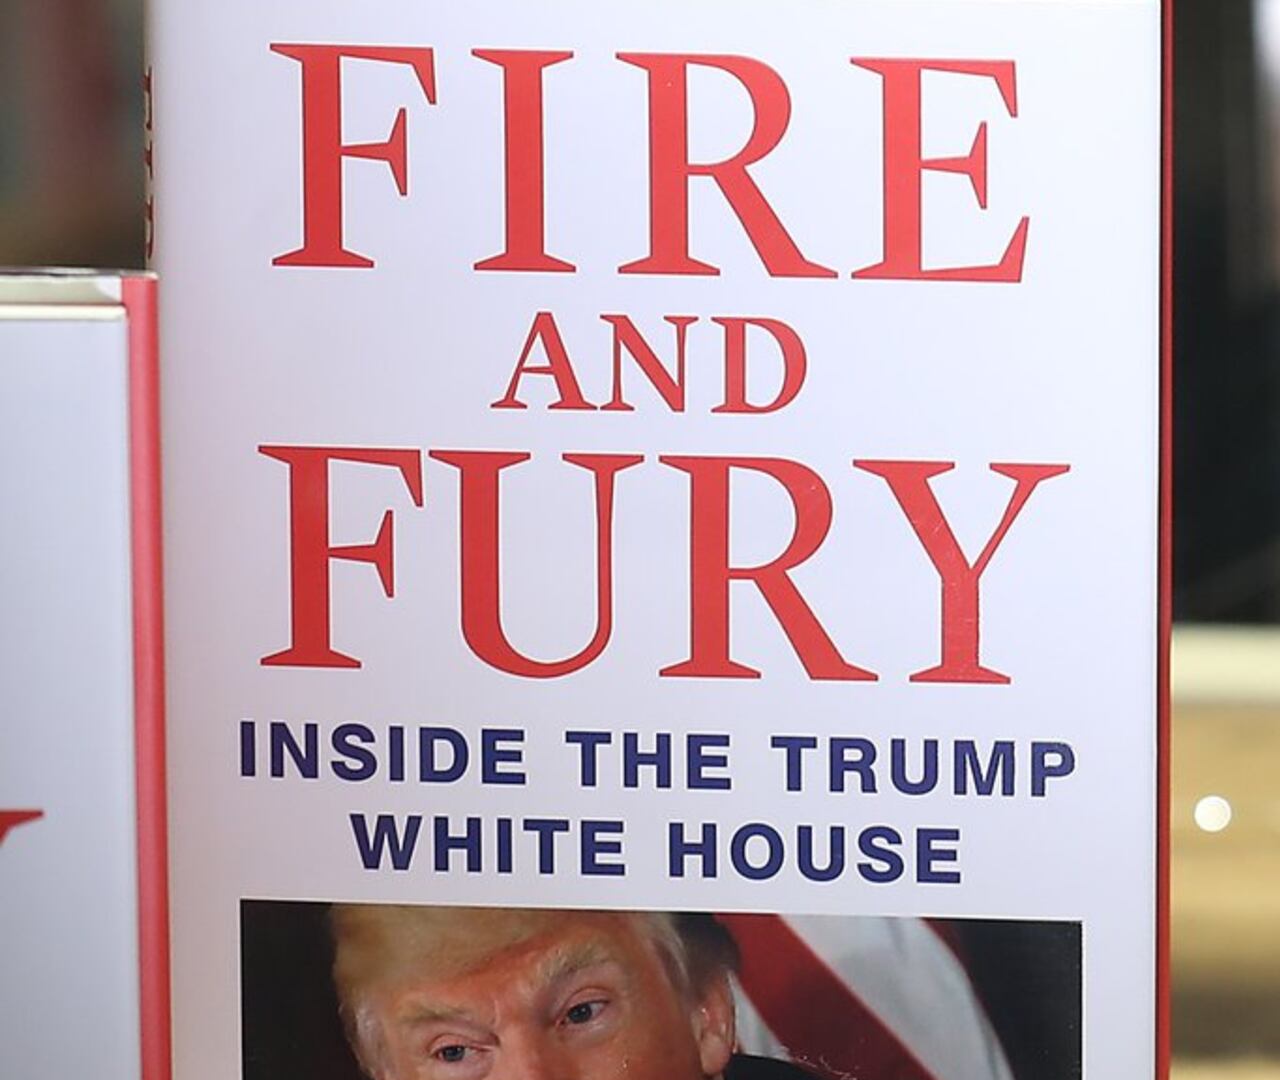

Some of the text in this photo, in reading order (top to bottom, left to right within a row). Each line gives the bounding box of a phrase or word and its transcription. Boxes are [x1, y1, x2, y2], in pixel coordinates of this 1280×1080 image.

[270, 42, 1030, 284] FIRE
[490, 311, 808, 414] AND
[257, 443, 1072, 685] FURY
[240, 720, 1076, 798] INSIDE THE TRUMP
[349, 813, 962, 884] WHITE HOUSE
